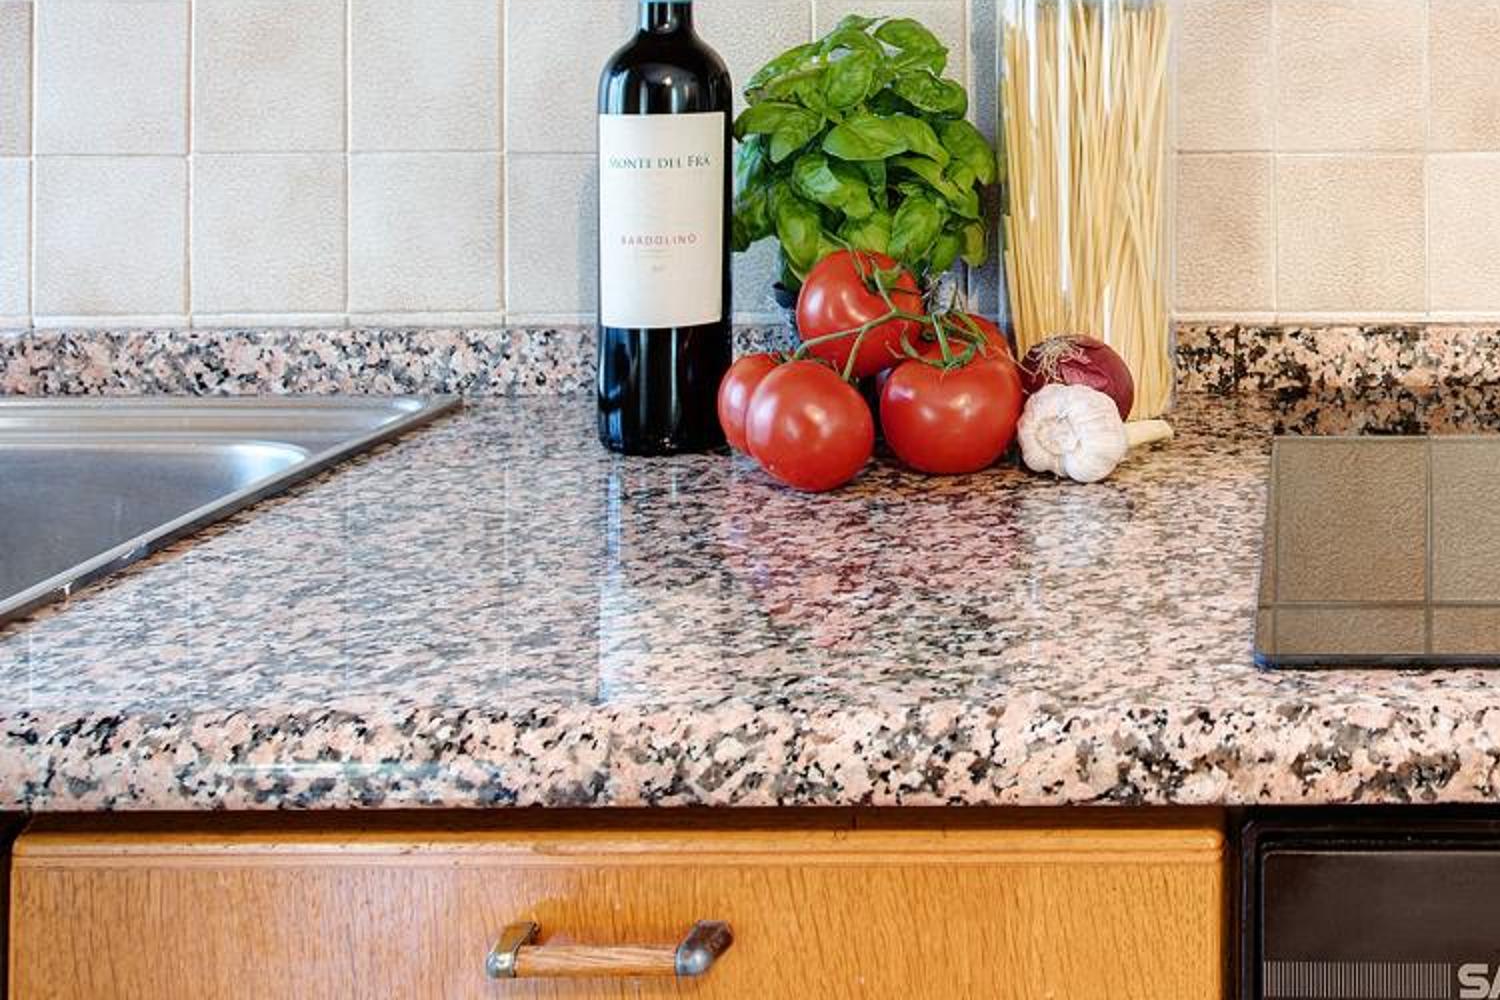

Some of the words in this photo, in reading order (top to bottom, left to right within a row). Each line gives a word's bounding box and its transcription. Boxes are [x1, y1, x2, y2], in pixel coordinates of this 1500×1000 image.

[608, 155, 651, 168] MONTE
[657, 156, 682, 168] DEL
[620, 233, 697, 246] BARDOLINO
